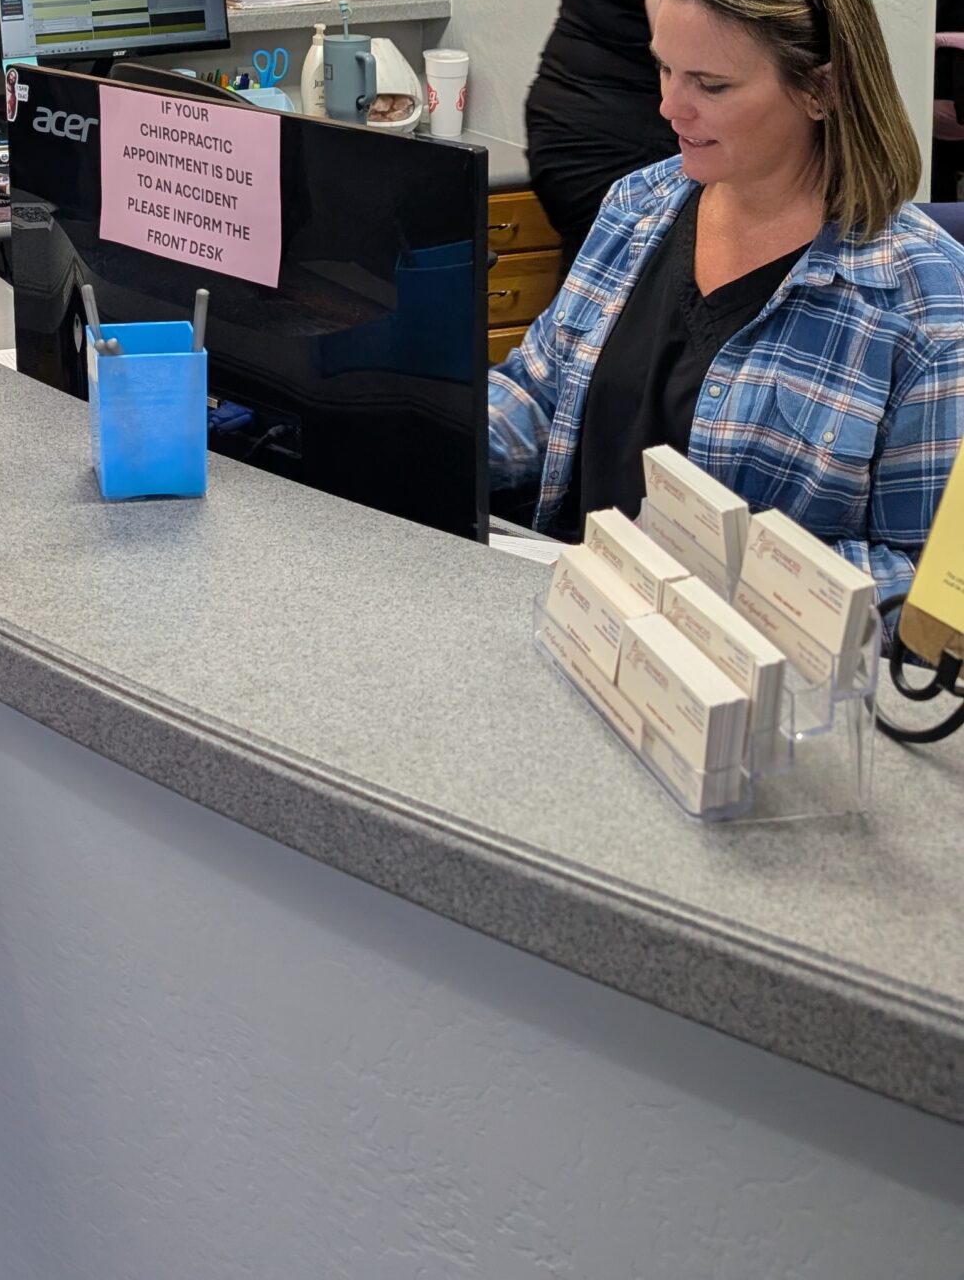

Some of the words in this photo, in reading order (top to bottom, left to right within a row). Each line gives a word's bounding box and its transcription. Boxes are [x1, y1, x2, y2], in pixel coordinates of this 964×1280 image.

[33, 106, 99, 142] acer
[161, 100, 172, 115] IF
[174, 102, 209, 122] YOUR
[140, 123, 233, 154] CHIROPRACTIC
[123, 145, 209, 176] APPOINTMENT
[211, 164, 223, 179] IS
[226, 167, 253, 186] DUE
[137, 173, 152, 189] TO
[155, 178, 172, 194] AN
[174, 183, 238, 210] ACCIDENT
[127, 196, 170, 220] PLEASE
[173, 208, 222, 234] INFORM
[225, 221, 251, 241] THE
[147, 229, 187, 252] FRONT
[189, 240, 224, 262] DESK
